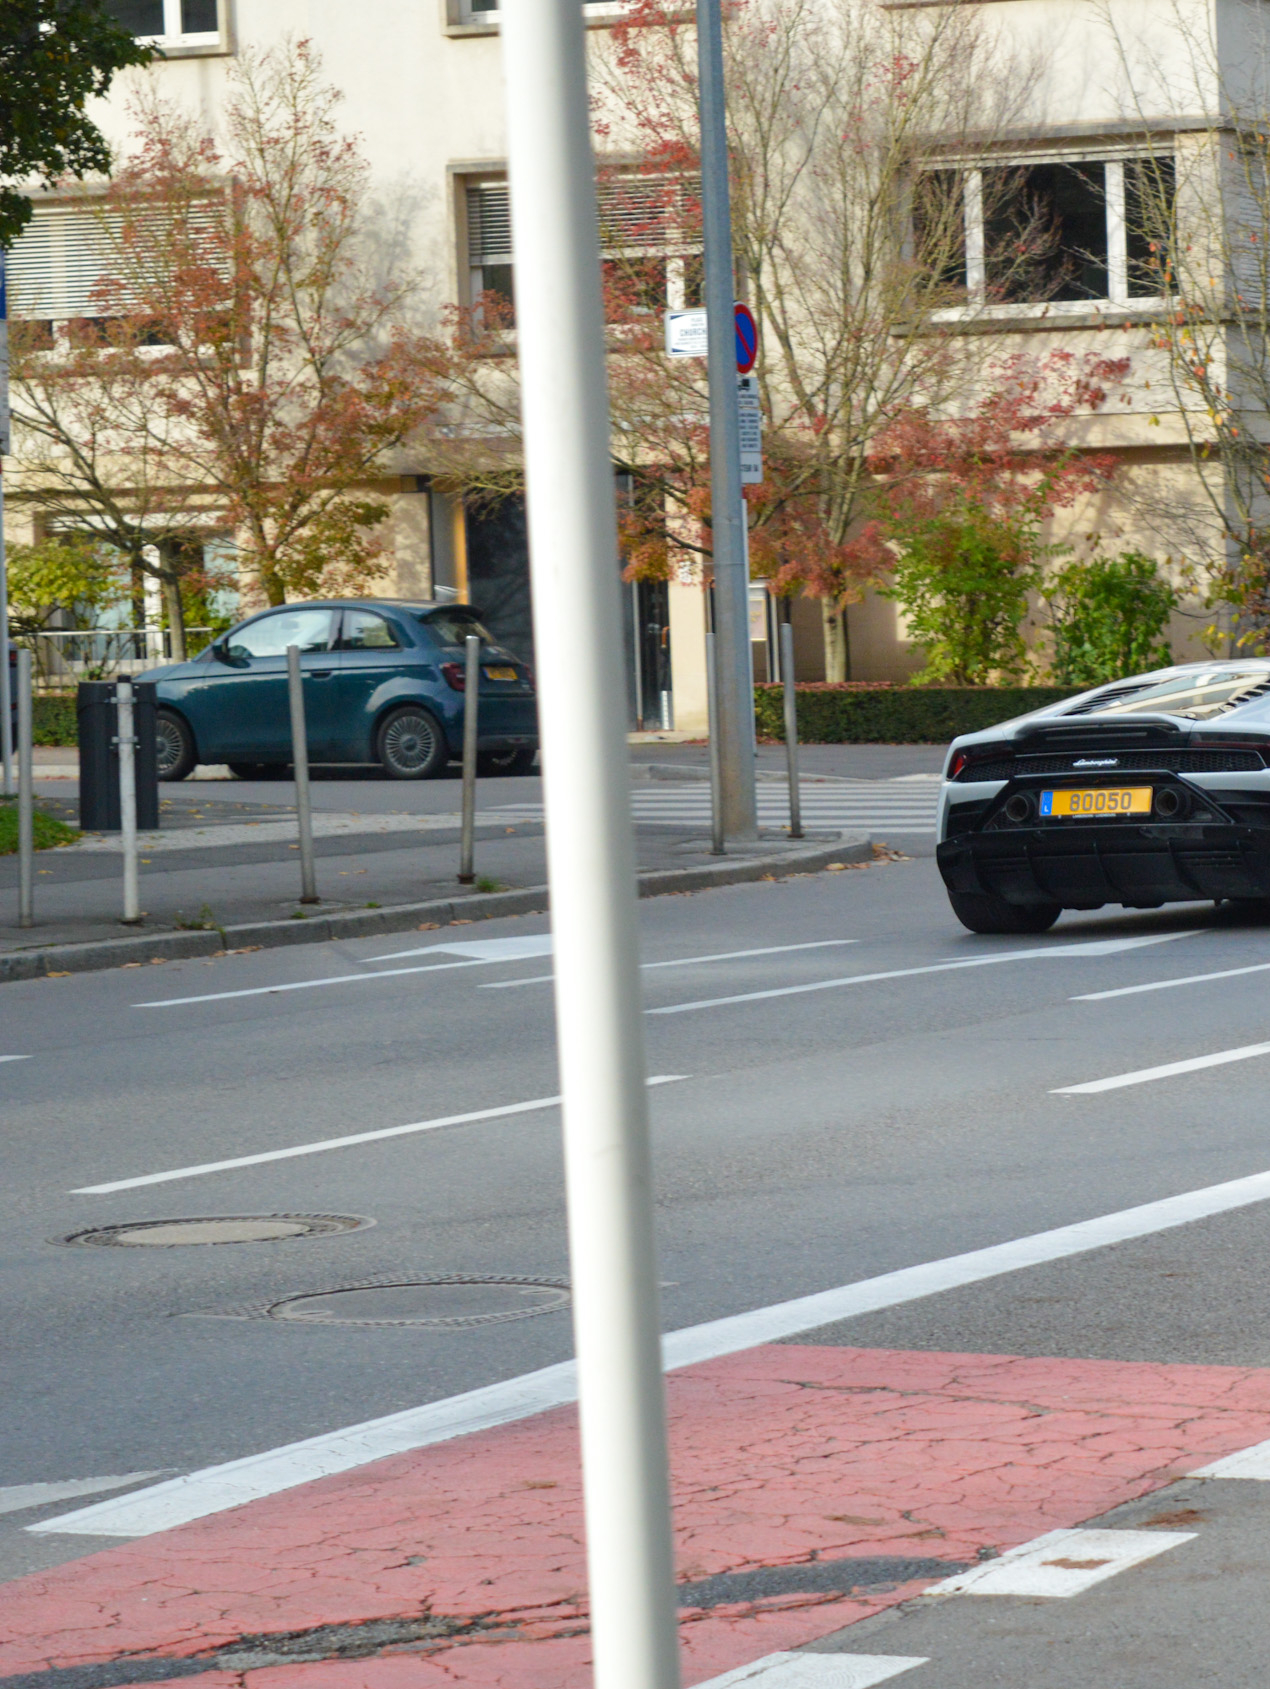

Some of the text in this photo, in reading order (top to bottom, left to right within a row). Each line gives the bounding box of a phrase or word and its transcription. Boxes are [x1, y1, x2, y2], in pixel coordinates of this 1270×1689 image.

[680, 328, 708, 337] CHURCH
[1072, 758, 1118, 767] Lamborghini
[1069, 791, 1132, 811] 80050
